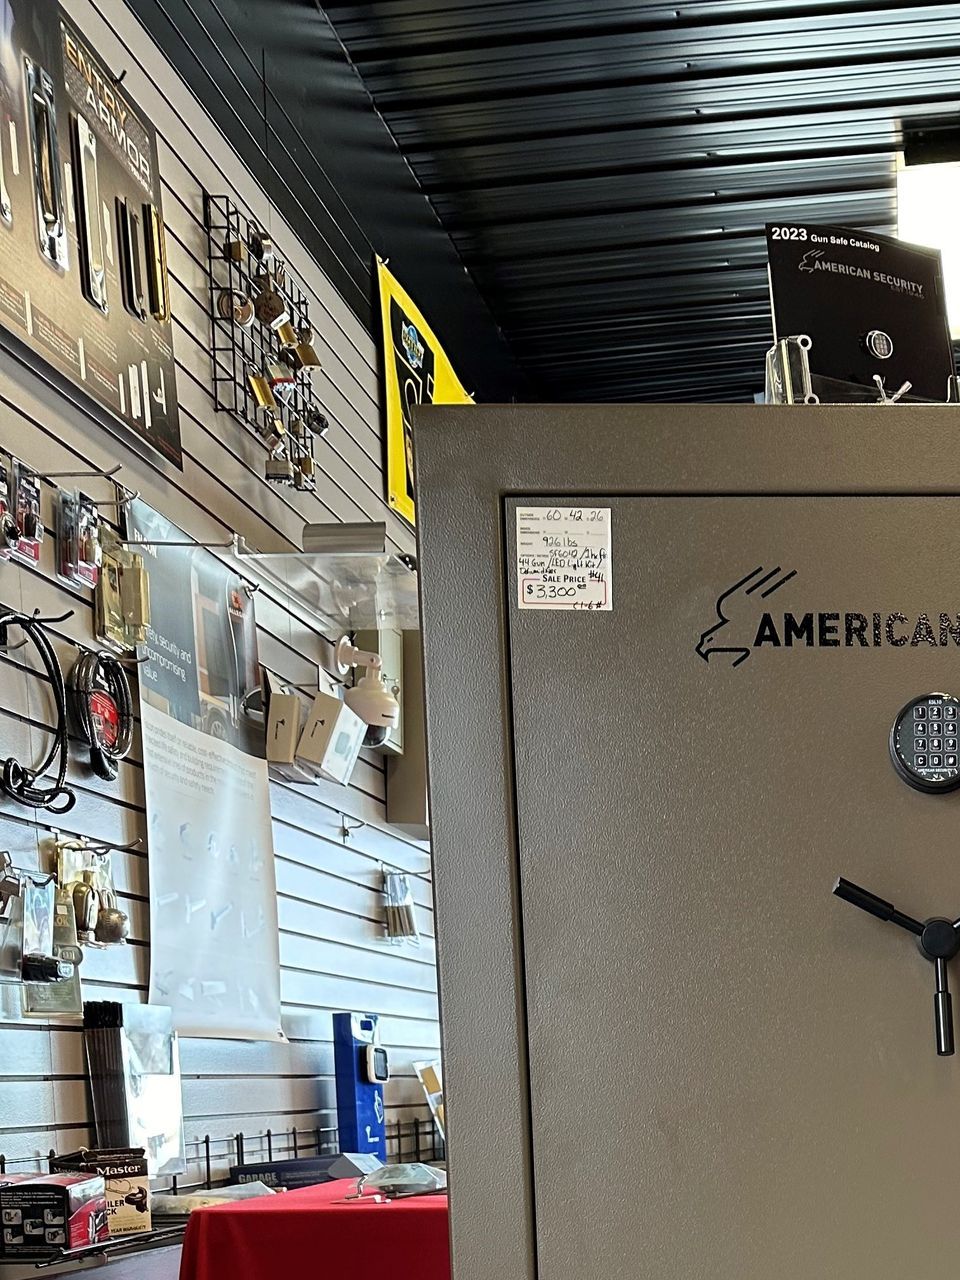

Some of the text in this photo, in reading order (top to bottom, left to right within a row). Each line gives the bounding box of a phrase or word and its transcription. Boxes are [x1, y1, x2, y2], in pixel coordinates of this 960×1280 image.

[65, 33, 127, 128] ENTRY
[86, 86, 151, 183] ARMOR
[771, 227, 880, 252] 2023 Gun Safe Catalog
[814, 260, 923, 294] AMERICAN SECURITY
[546, 509, 604, 521] 60 42 26
[543, 536, 578, 547] 926 lbs
[542, 574, 586, 583] SALE PRICE
[96, 1165, 141, 1176] Master
[238, 1172, 277, 1184] GARAGE
[107, 1199, 125, 1208] ILER
